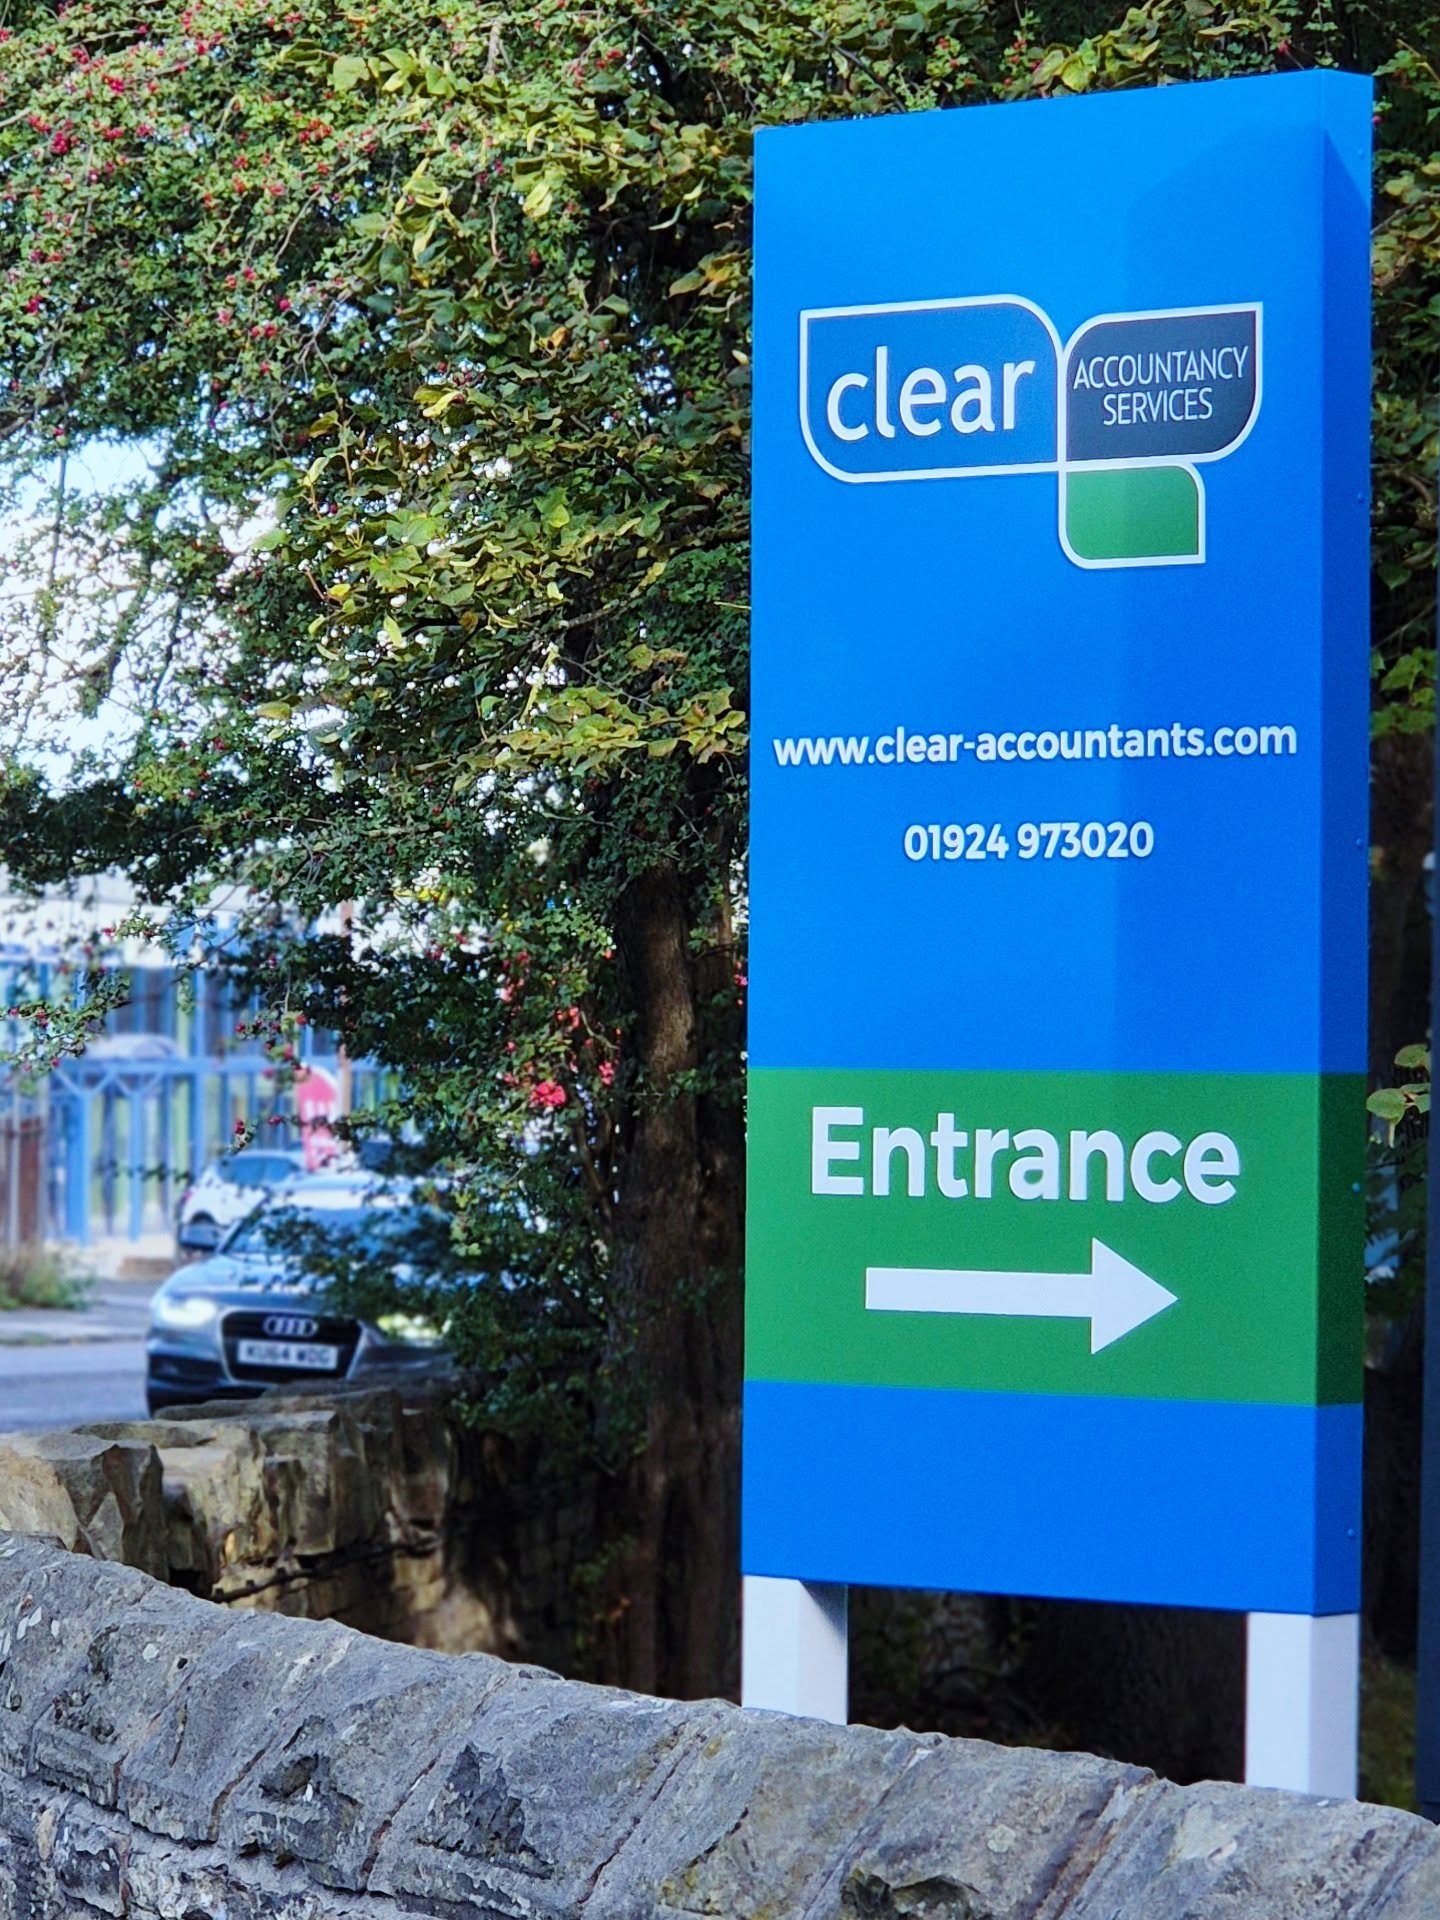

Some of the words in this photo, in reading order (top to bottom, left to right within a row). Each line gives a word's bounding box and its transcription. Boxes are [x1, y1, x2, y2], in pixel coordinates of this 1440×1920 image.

[1073, 345, 1249, 390] ACCOUNTANCY
[826, 346, 1036, 441] clear
[1102, 387, 1213, 426] SERVICES
[773, 723, 1297, 766] www.clear-accountants.com
[904, 823, 1009, 861] 01924
[1017, 821, 1154, 859] 973020
[811, 1106, 1240, 1204] Entrance
